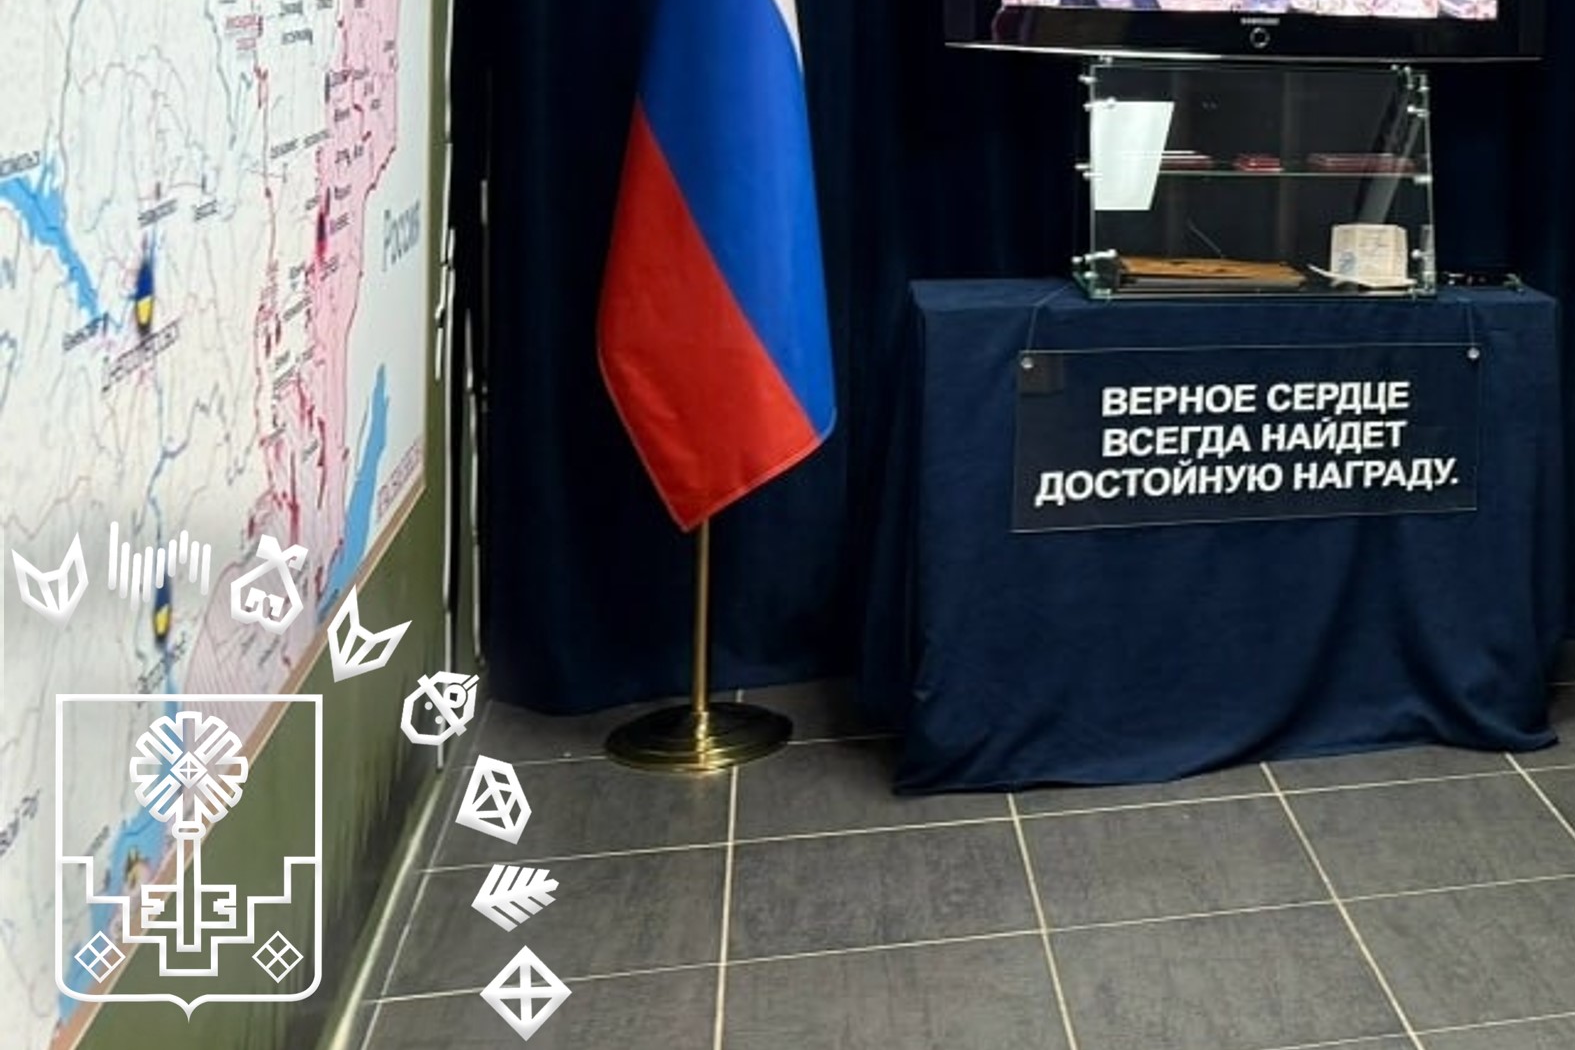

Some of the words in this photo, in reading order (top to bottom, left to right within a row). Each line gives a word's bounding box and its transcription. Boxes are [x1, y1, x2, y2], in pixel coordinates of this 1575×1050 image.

[1102, 384, 1257, 417] ВЕРНОЕ
[1267, 381, 1410, 416] СЕРДЦЕ
[1102, 423, 1251, 460] ВСЕГДА
[1261, 416, 1408, 455] НАЙДЕТ
[1034, 458, 1283, 507] ДОСТОЙНУЮ
[1294, 458, 1459, 492] НАГРАДУ.
